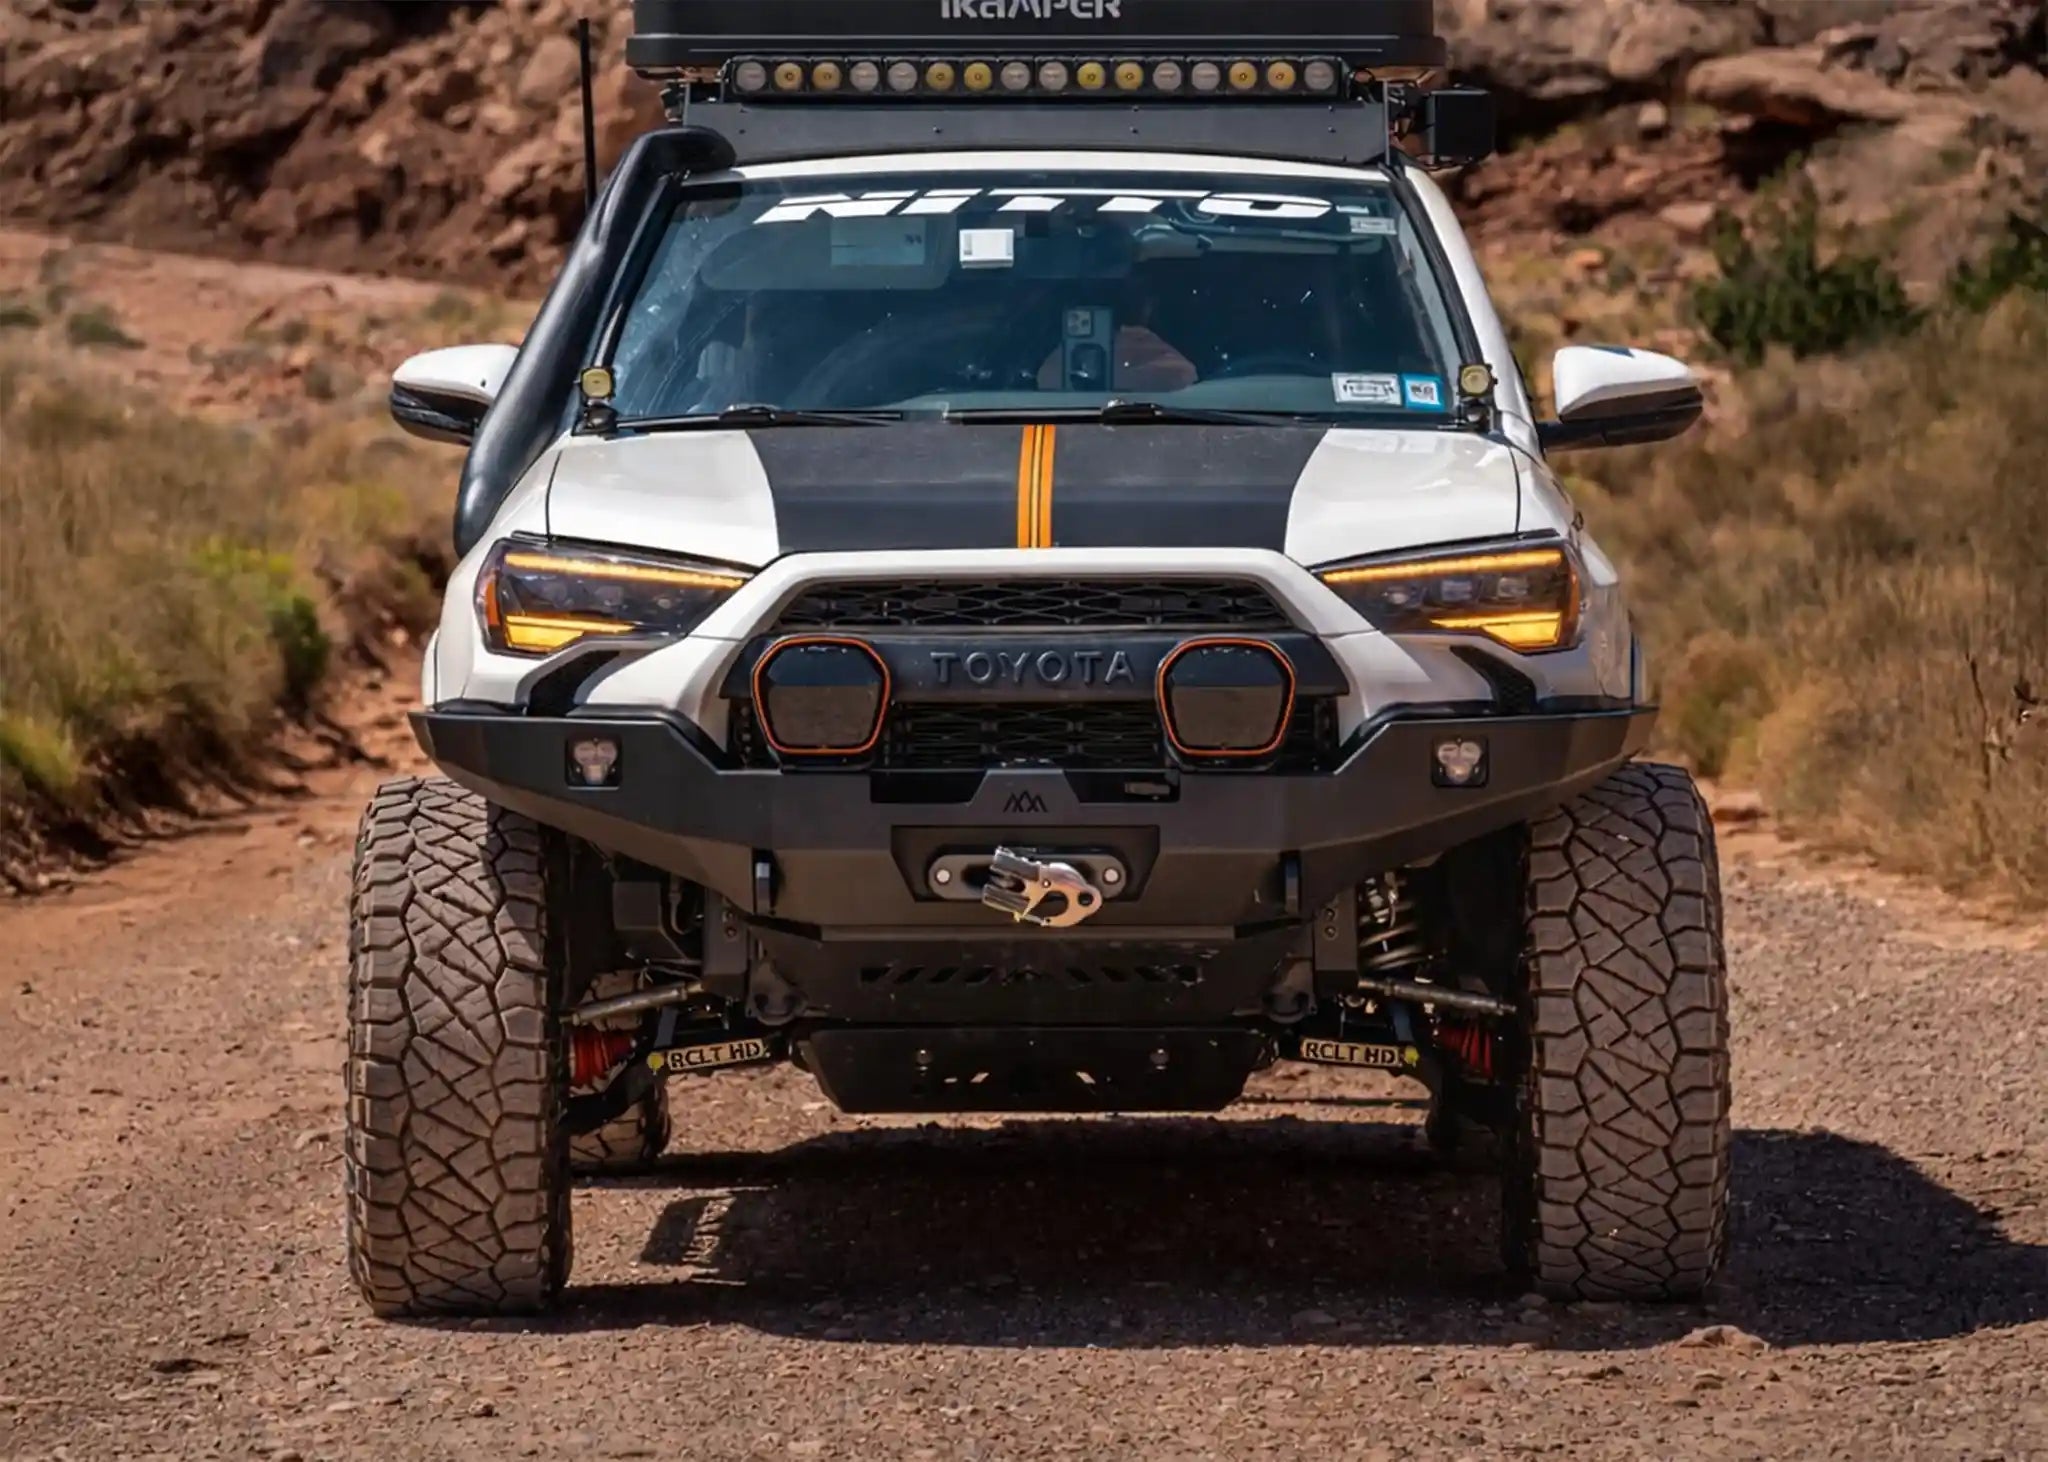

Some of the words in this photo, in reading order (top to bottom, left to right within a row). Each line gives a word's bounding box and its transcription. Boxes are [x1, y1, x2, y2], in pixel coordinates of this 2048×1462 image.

[753, 188, 1331, 224] NITTO
[930, 651, 1135, 683] TOYOTA
[670, 1045, 723, 1068] RCLT
[728, 1040, 761, 1060] HD
[1304, 1041, 1359, 1062] RCLT
[1363, 1046, 1396, 1064] HD
